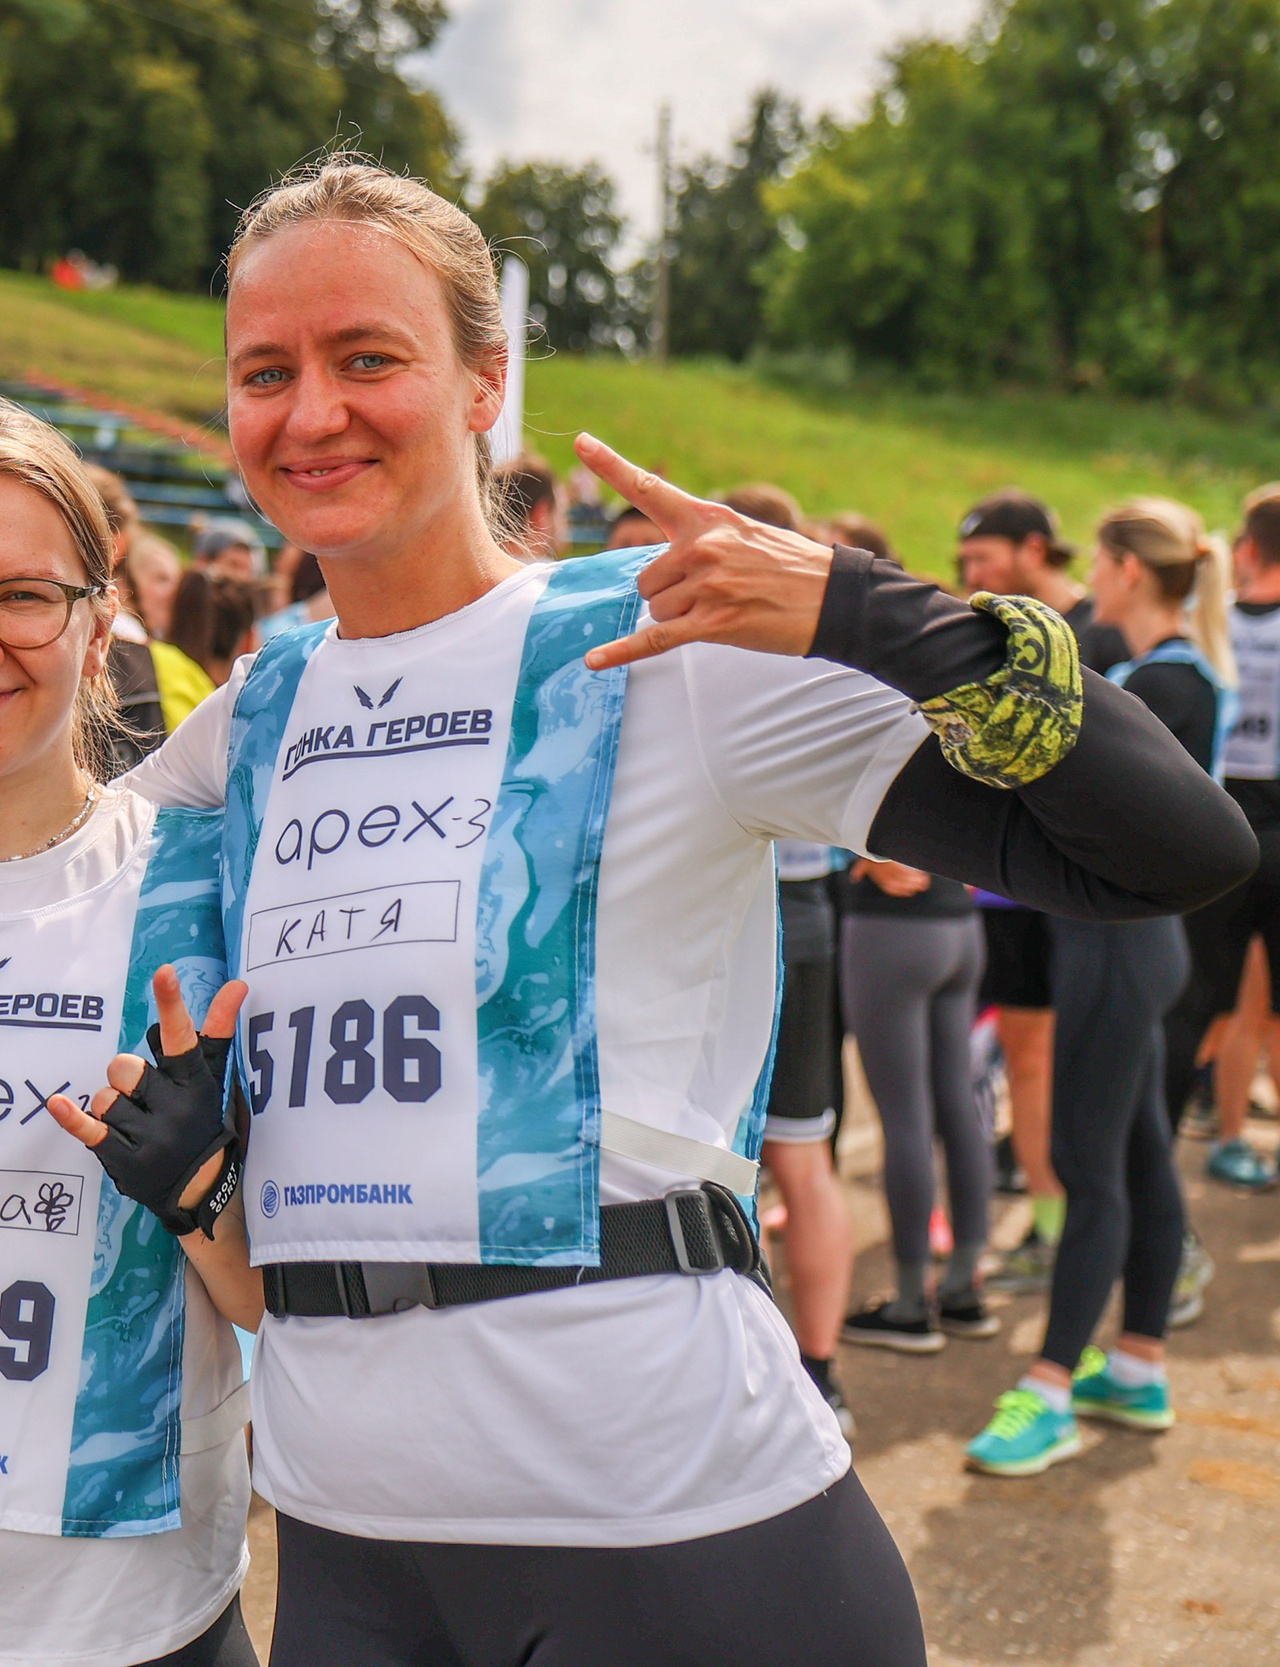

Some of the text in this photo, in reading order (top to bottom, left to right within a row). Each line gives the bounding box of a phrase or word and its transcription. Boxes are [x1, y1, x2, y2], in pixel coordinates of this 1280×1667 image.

[284, 708, 493, 771] ГОНКА ГЕРОЕВ
[276, 898, 402, 957] КАТЯ
[249, 995, 441, 1115] 5186
[209, 1162, 236, 1210] SPORT
[284, 1184, 413, 1206] ГАЗПРОМБАНК
